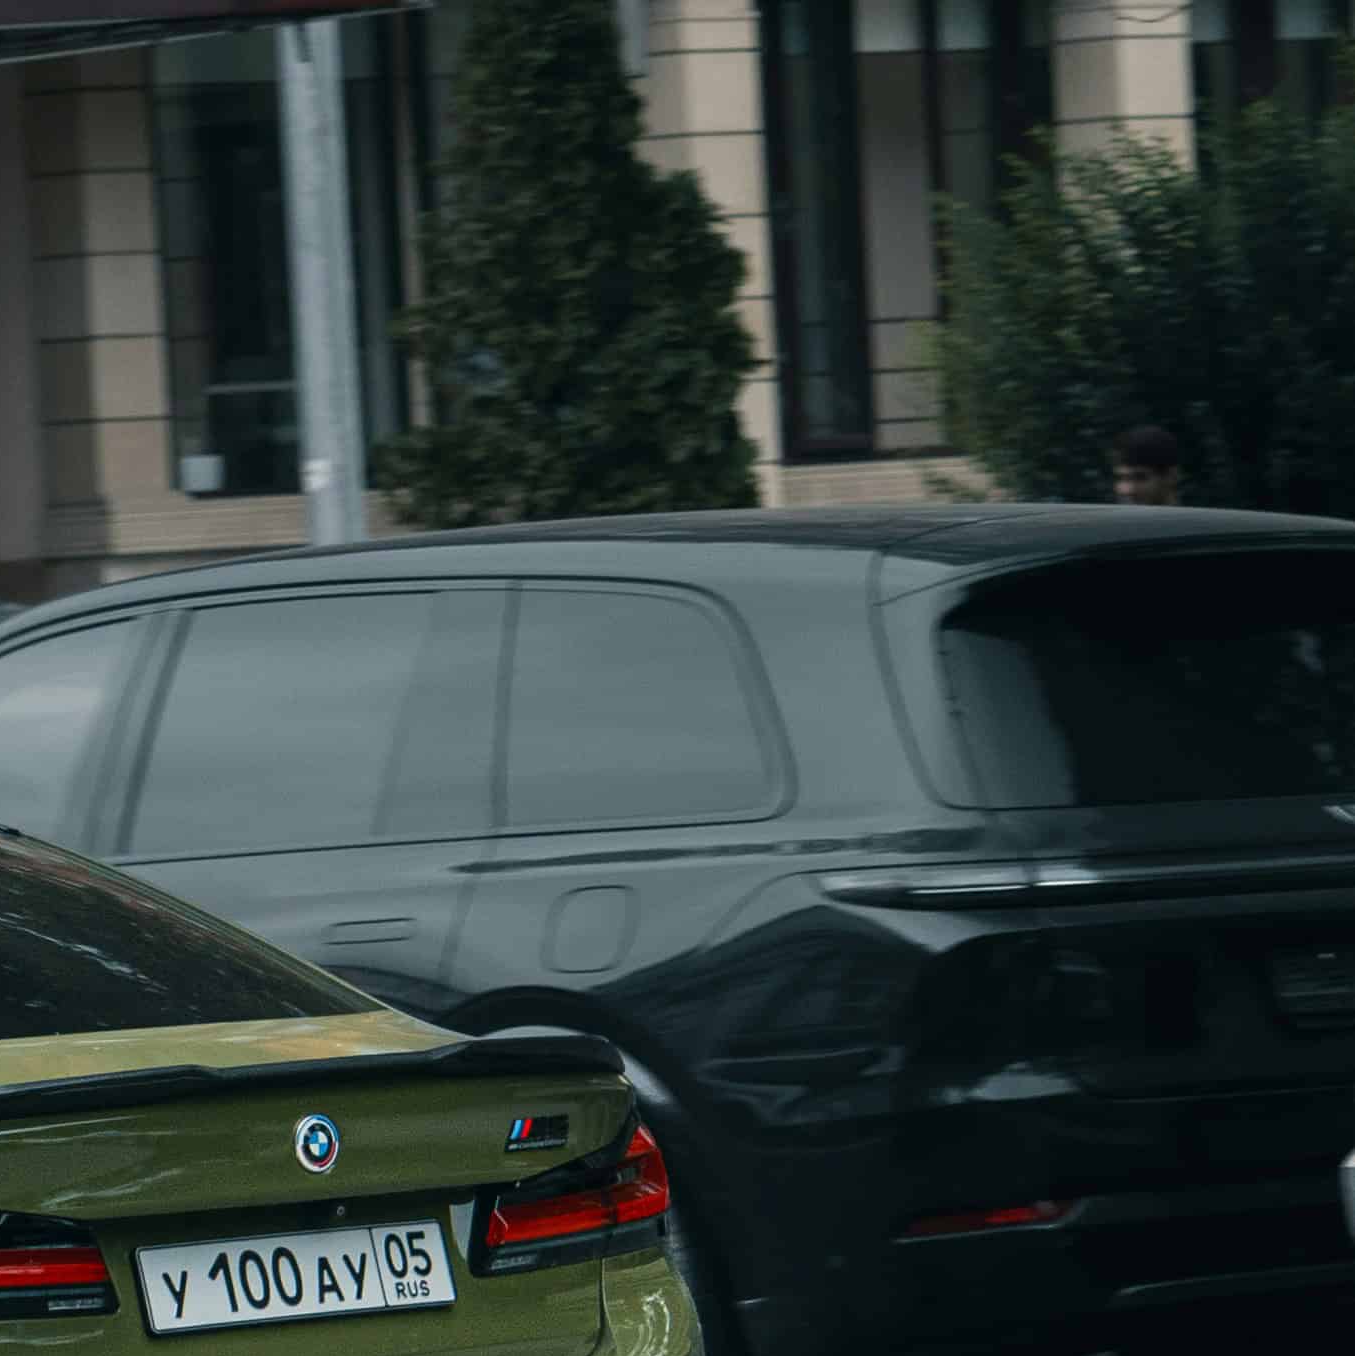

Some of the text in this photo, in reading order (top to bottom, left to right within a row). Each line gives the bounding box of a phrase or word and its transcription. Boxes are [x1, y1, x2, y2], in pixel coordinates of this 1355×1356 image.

[208, 1247, 303, 1312] 100
[384, 1230, 432, 1278] 05
[395, 1279, 430, 1299] RUS
